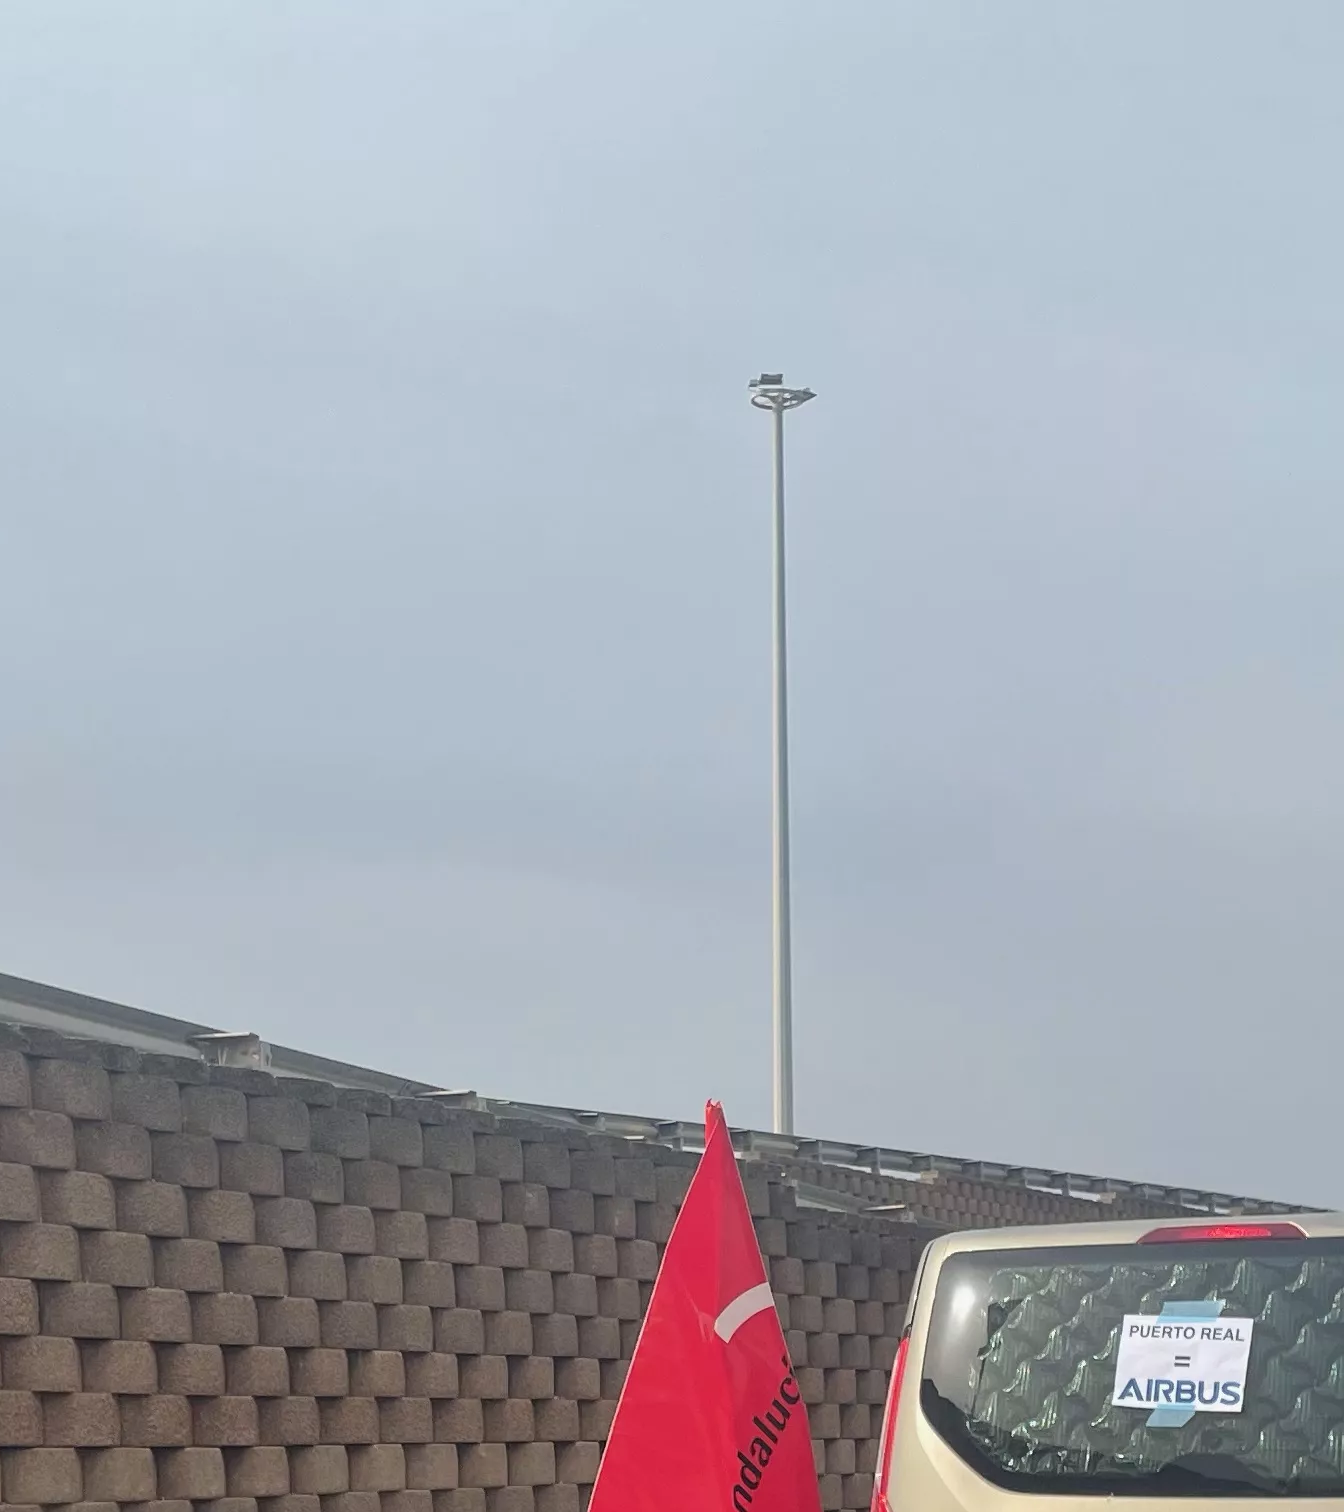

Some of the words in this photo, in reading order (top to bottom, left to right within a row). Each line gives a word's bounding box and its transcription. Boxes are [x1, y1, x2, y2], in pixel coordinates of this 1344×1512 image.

[1129, 1325, 1195, 1340] PUERTO
[1200, 1327, 1245, 1342] REAL
[1117, 1377, 1242, 1406] AIRBUS
